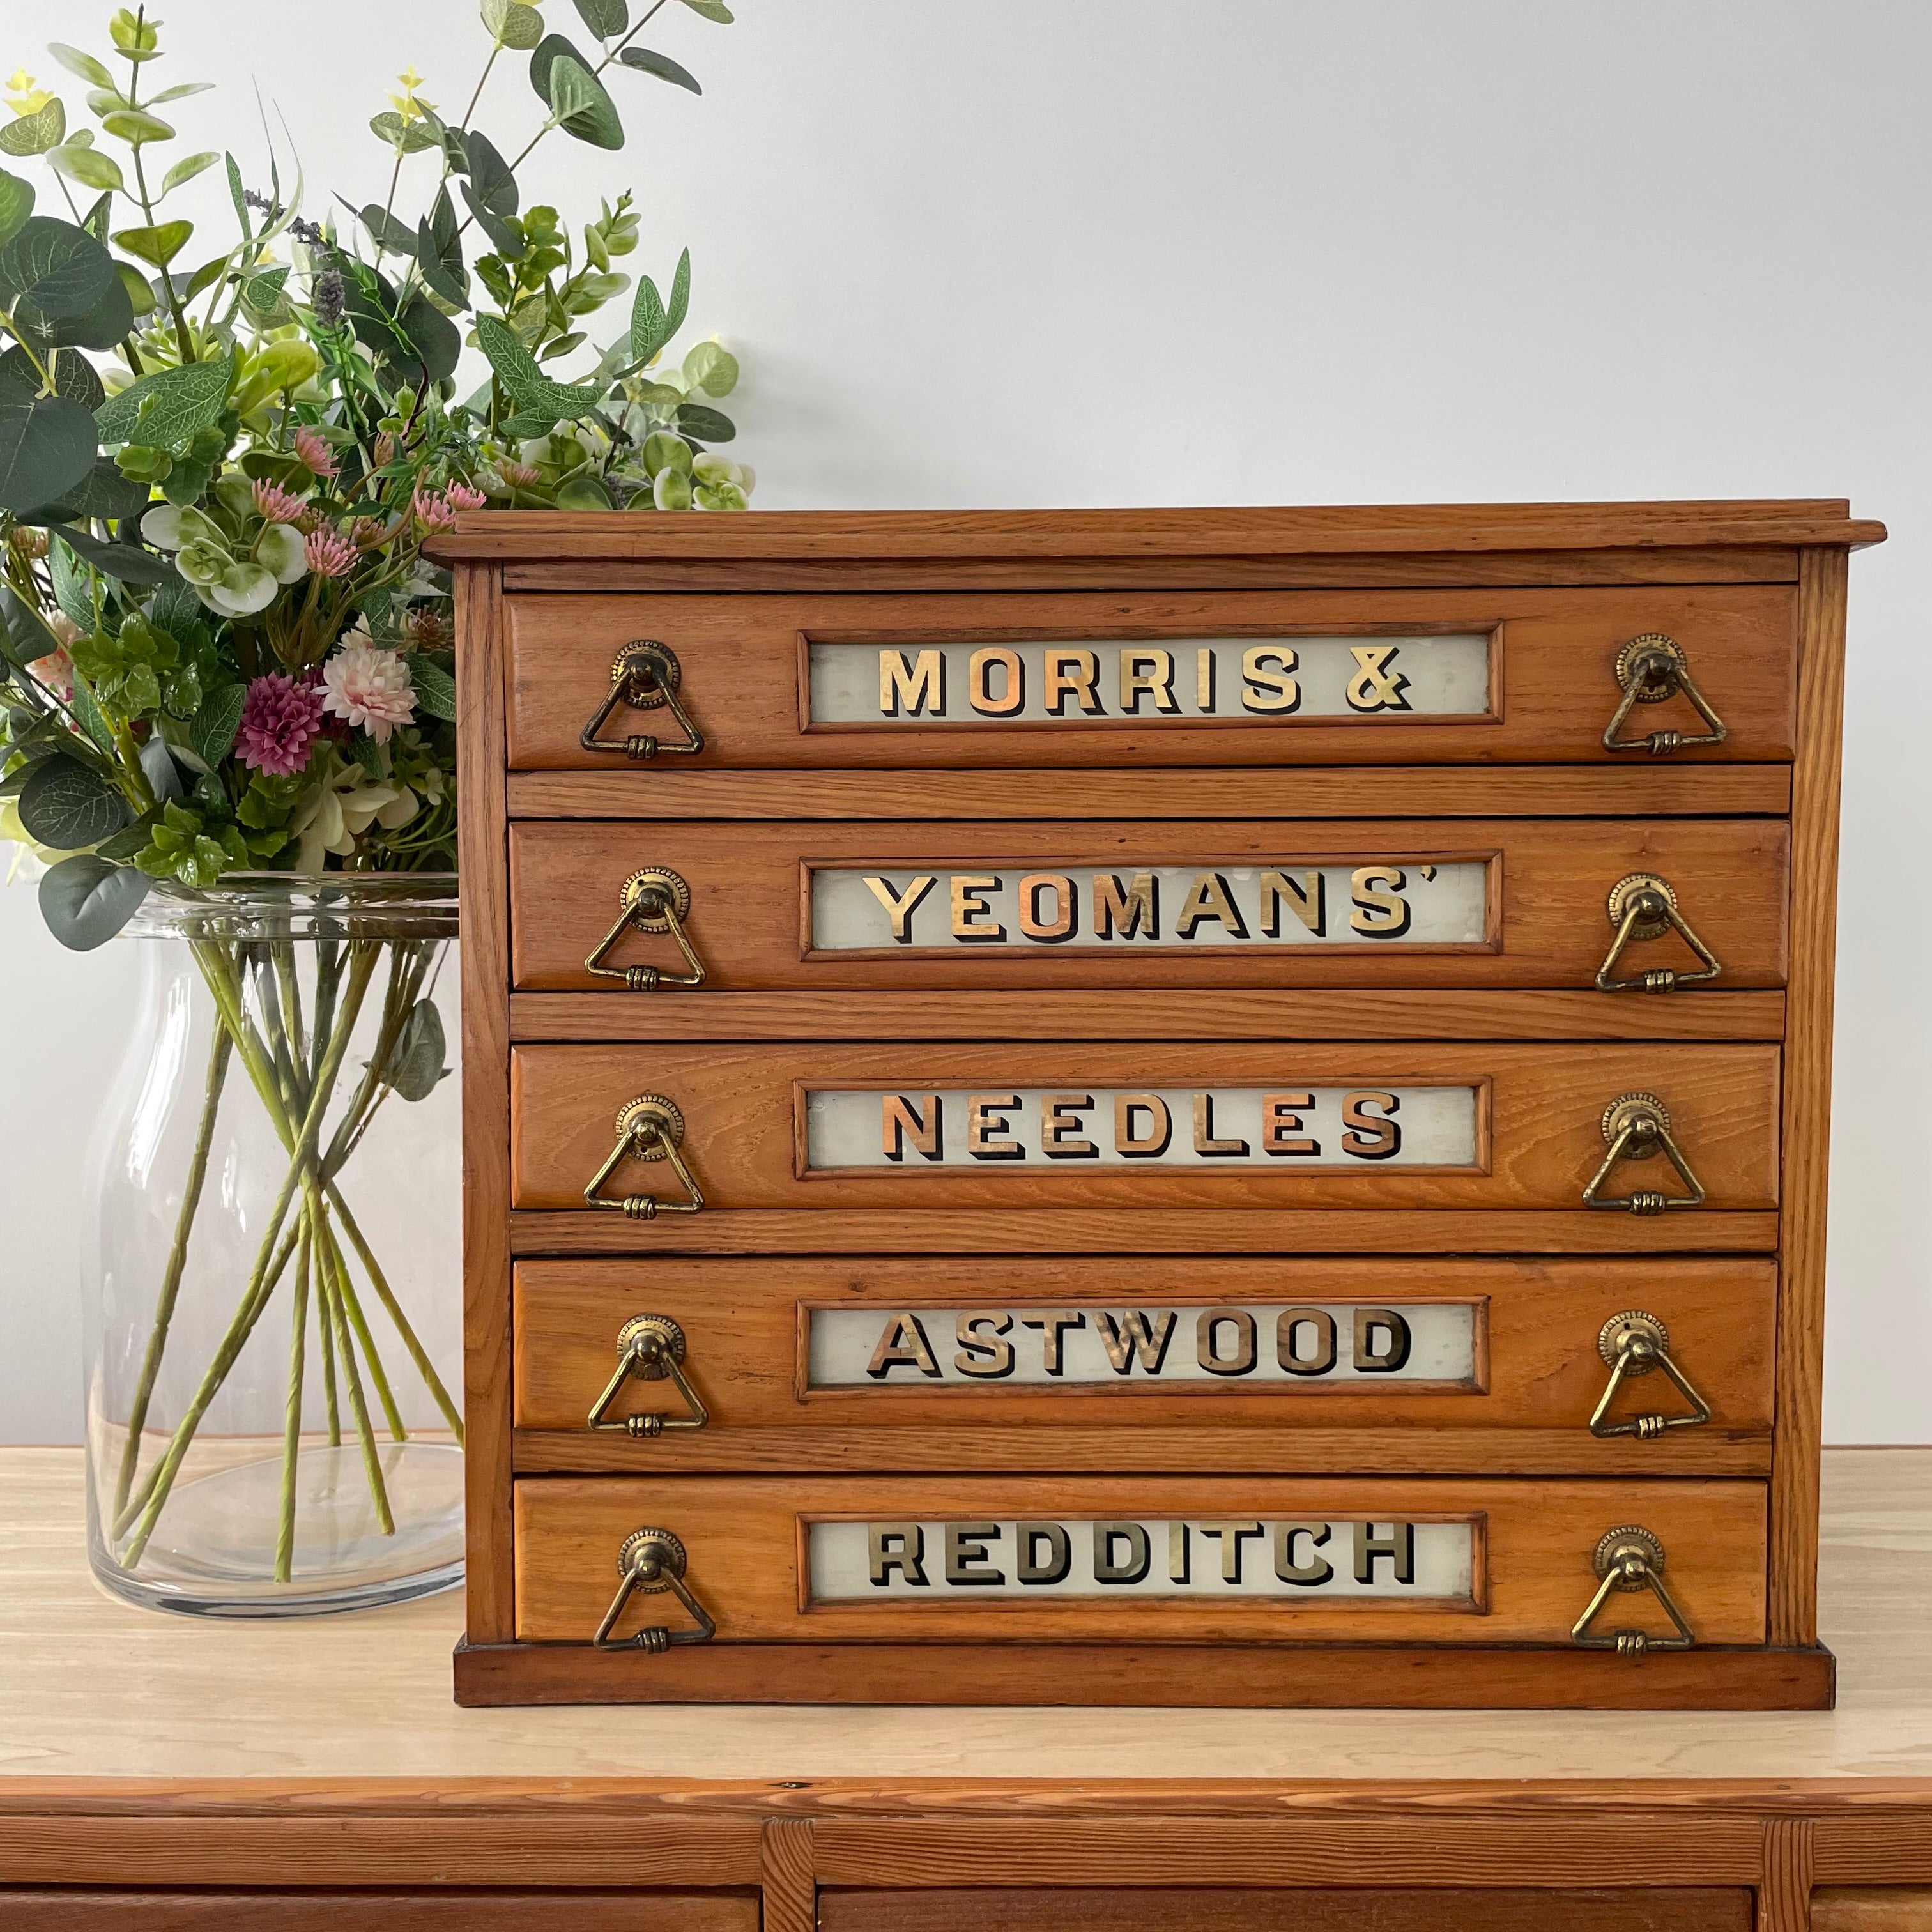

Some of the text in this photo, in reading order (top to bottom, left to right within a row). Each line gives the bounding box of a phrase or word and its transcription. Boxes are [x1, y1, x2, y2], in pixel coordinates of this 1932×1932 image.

[879, 645, 1414, 717] MORRIS &
[882, 1090, 1403, 1162] NEEDLES
[866, 1307, 1413, 1379] ASTWOOD
[868, 1521, 1416, 1588] REDDITCH
